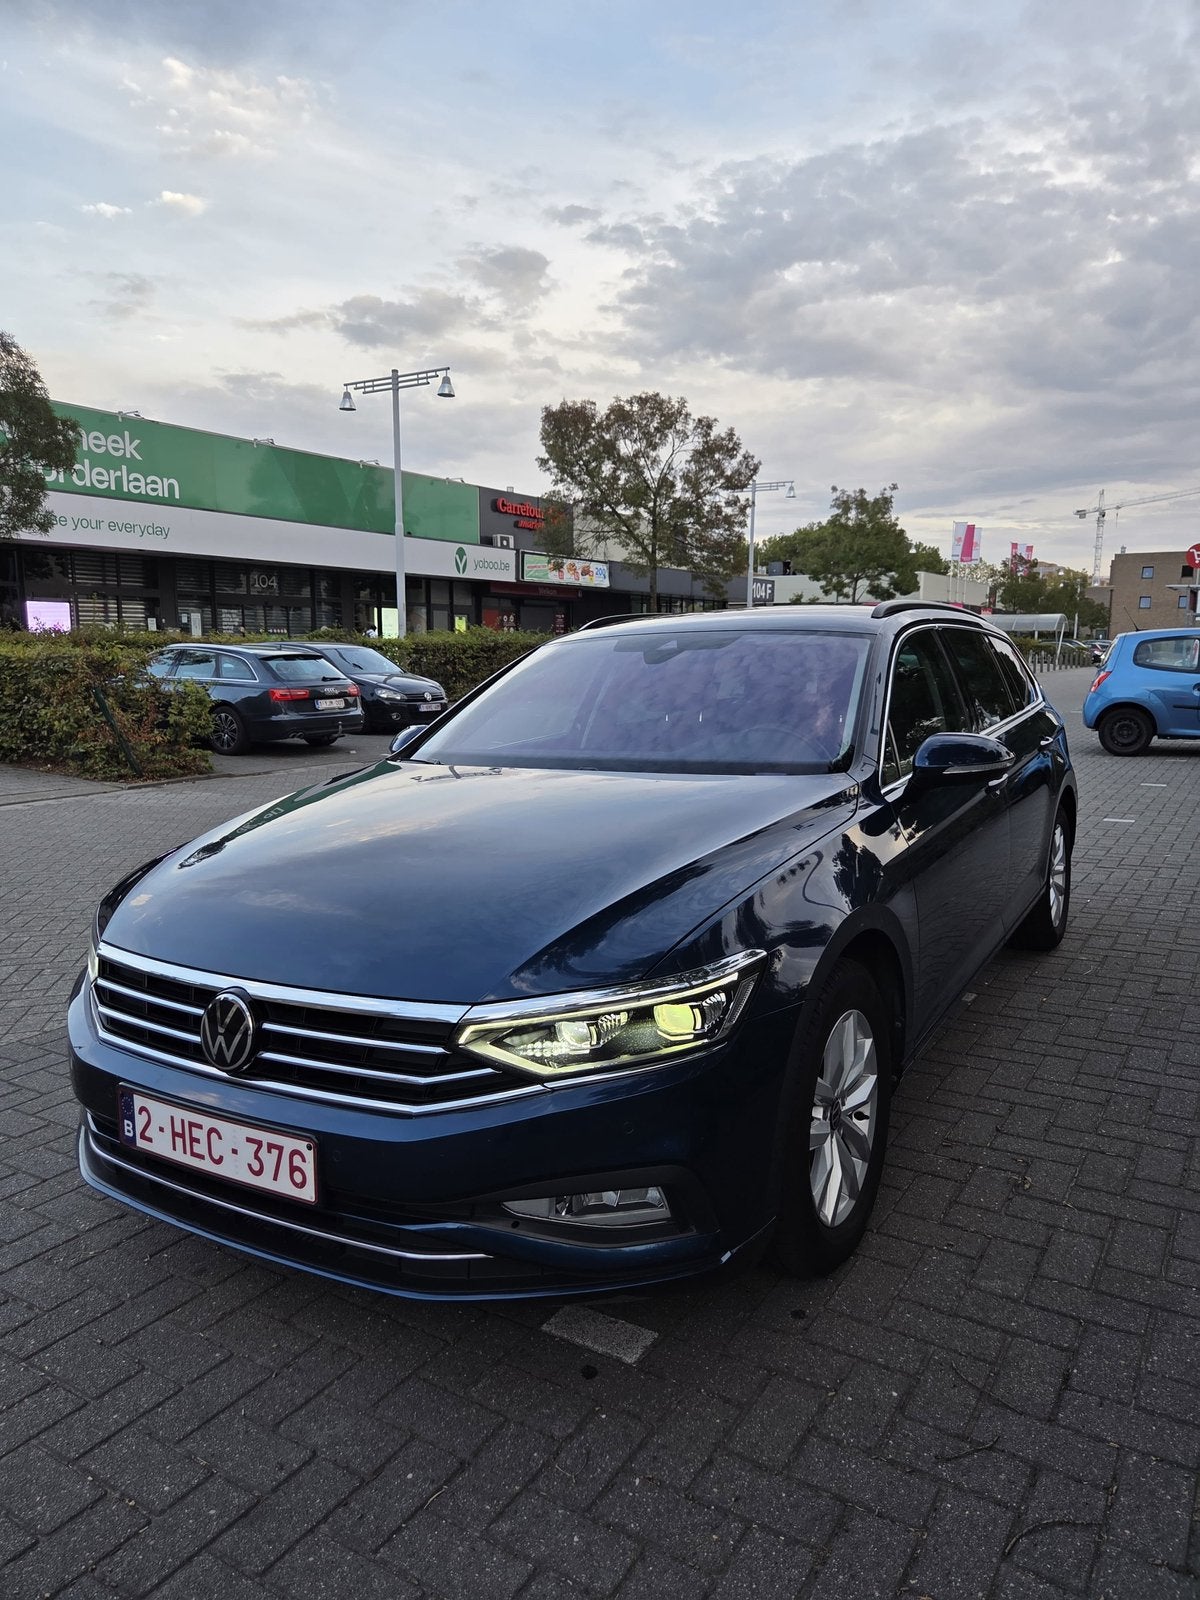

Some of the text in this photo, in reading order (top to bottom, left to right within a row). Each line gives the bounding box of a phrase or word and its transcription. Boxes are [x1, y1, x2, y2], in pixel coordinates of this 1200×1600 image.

[71, 516, 104, 531] your
[108, 519, 170, 540] everyday
[474, 558, 510, 571] yoboo.be
[253, 574, 278, 589] 104
[124, 1119, 134, 1137] B
[138, 1105, 308, 1190] 2-HEC-376
